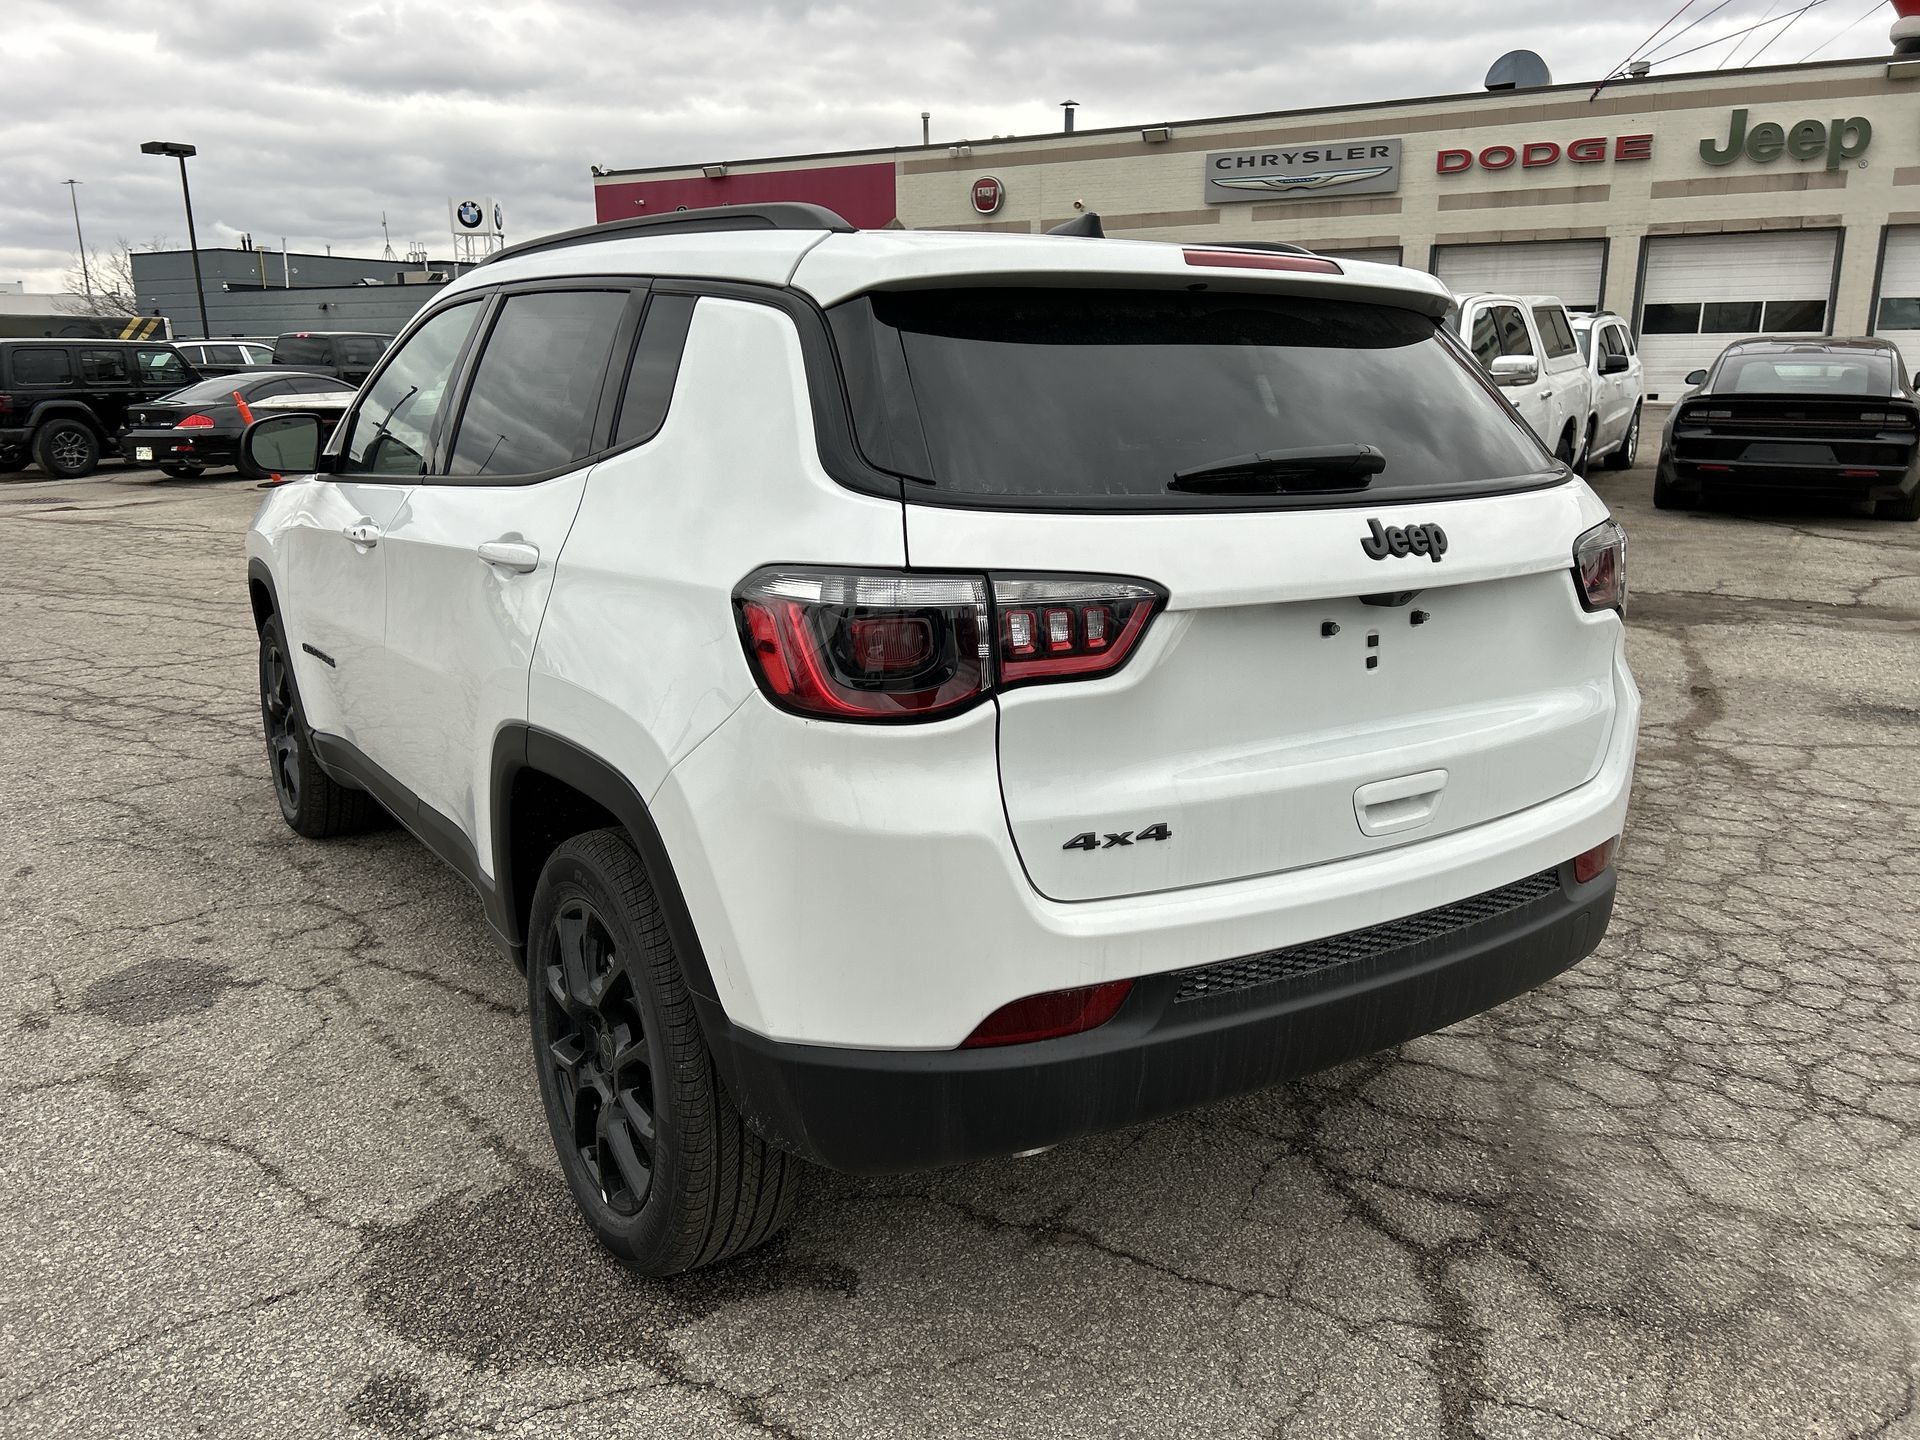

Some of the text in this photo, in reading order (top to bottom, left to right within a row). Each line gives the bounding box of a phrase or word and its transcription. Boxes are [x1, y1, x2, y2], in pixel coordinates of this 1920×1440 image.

[1216, 146, 1390, 169] CHRYSLER
[1436, 134, 1653, 174] DODGE
[1699, 108, 1872, 170] Jeep
[1360, 518, 1448, 562] Jeep
[1062, 823, 1172, 850] 4x4
